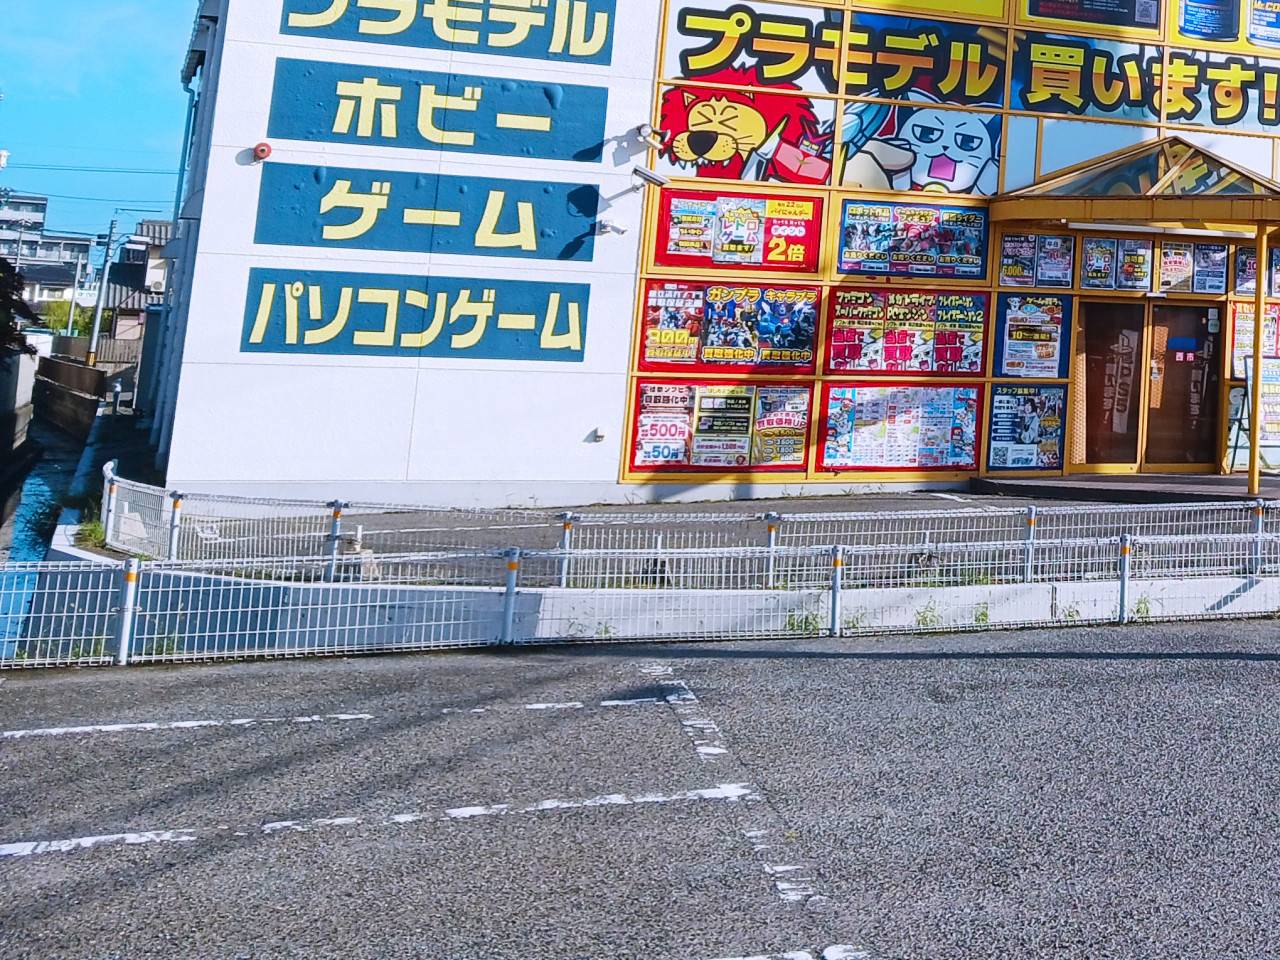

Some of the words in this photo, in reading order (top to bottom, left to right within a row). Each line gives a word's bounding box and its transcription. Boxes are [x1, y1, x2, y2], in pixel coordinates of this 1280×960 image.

[679, 7, 1004, 106] プラモデル
[332, 78, 552, 146] ホビー
[320, 179, 538, 251] ゲーム
[722, 218, 759, 231] レトロ
[719, 230, 759, 244] ゲーム
[766, 236, 806, 262] 2倍
[708, 287, 761, 303] ガンプラ
[764, 289, 817, 304] キャラプラ
[836, 291, 873, 304] ファミコン
[248, 281, 582, 351] パソコンゲーム
